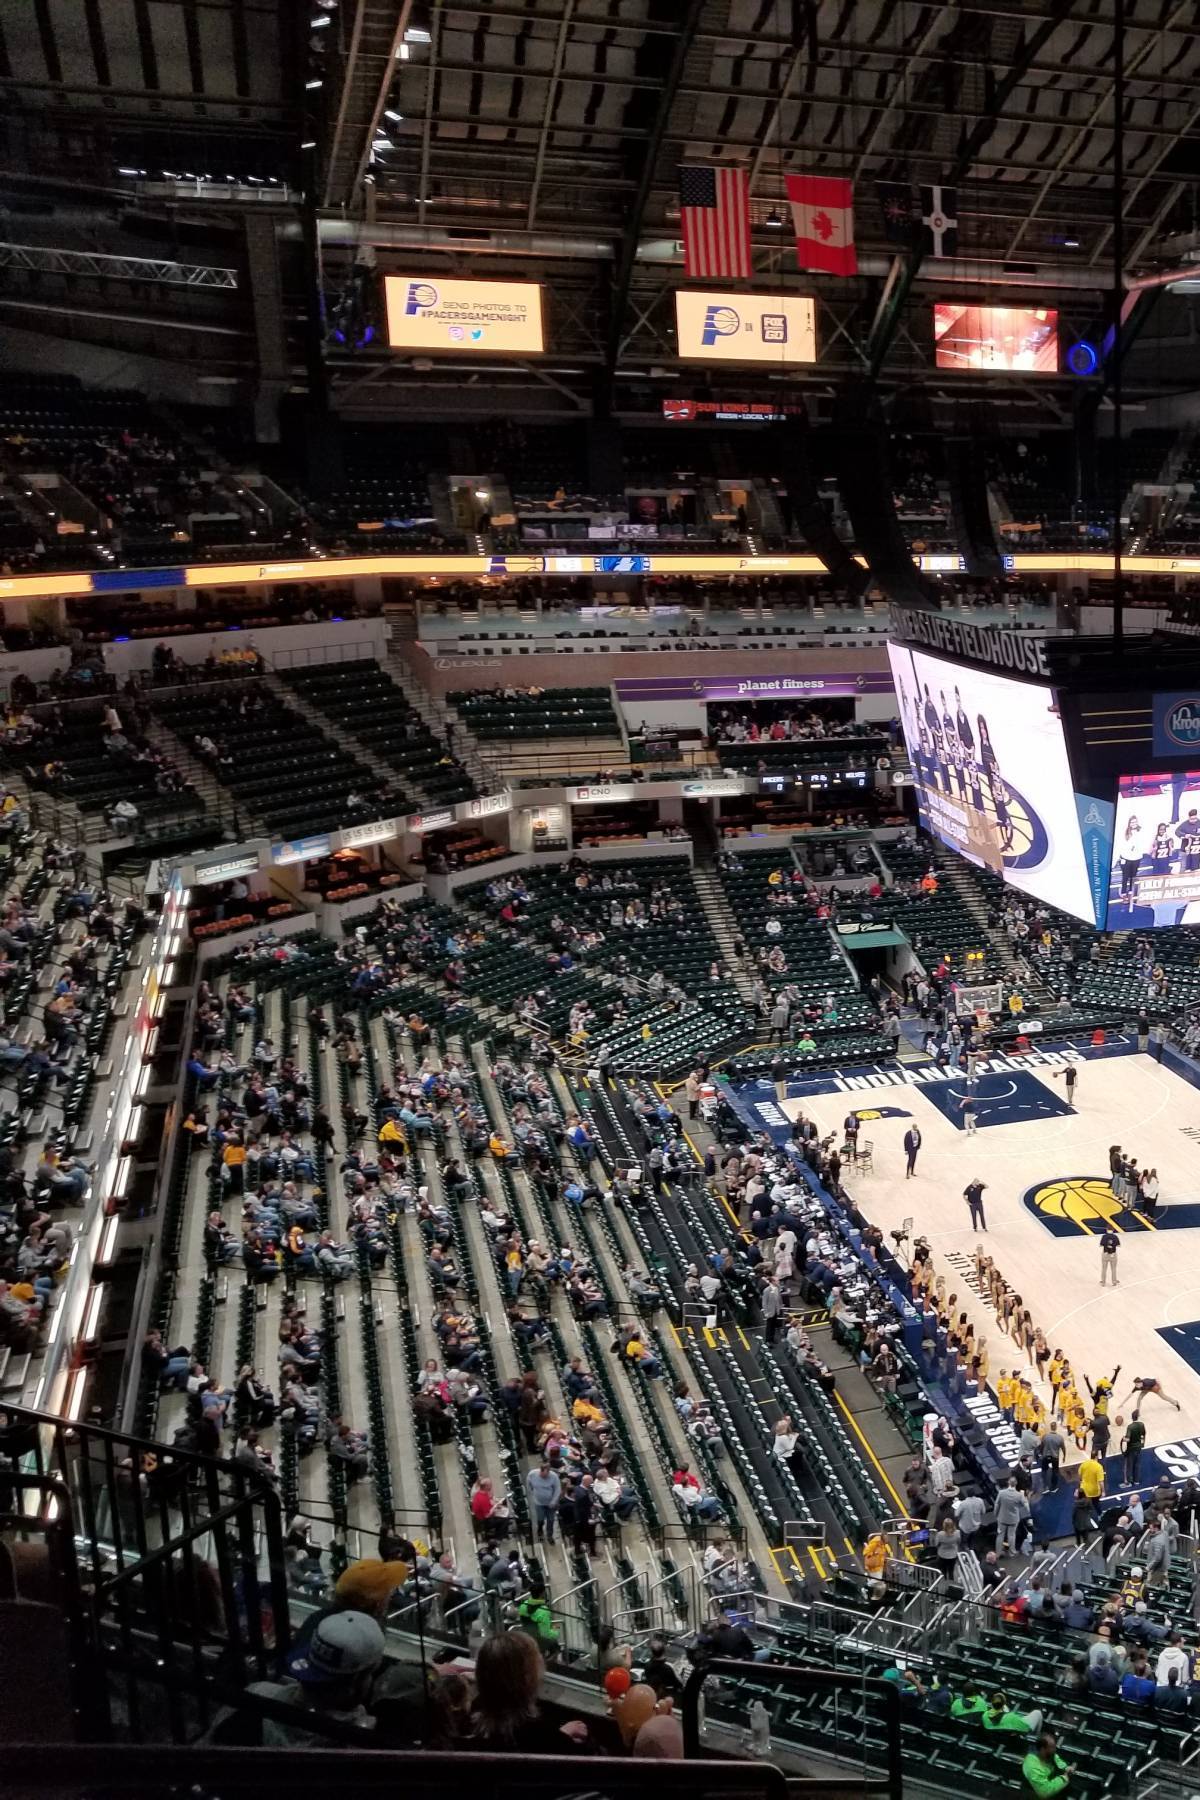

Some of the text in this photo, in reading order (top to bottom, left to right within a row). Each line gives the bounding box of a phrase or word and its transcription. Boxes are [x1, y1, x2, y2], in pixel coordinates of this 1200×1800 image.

[442, 301, 527, 312] SEND PHOTOS TO
[421, 309, 527, 323] #PACERSGAMENIGHT
[697, 402, 720, 412] SUN
[722, 403, 749, 413] KING
[928, 614, 953, 651] LIFE
[952, 621, 1051, 676] FIELDHOUSE
[738, 678, 825, 693] planet fitness
[591, 788, 611, 796] CNO
[196, 865, 221, 878] SPORT
[833, 1050, 1087, 1092] INDIANA PACERS
